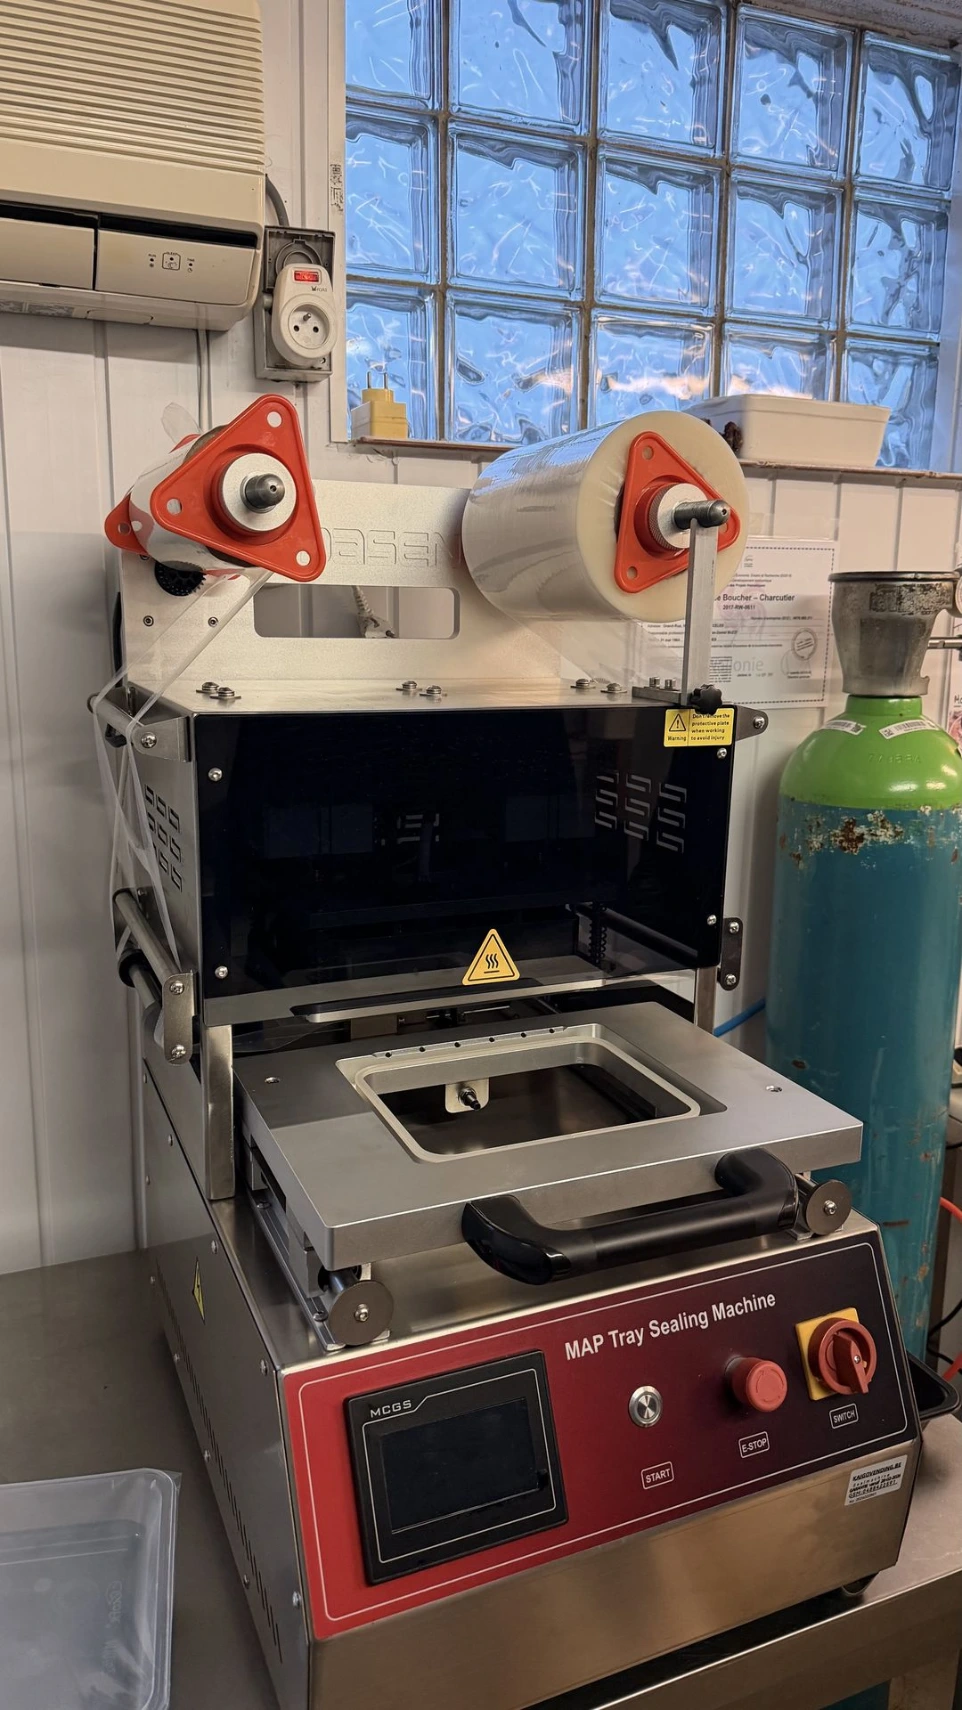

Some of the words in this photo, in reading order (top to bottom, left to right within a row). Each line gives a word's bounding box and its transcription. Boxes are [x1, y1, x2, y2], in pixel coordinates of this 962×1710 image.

[722, 593, 752, 602] Boucher
[759, 593, 795, 602] Charcutier
[565, 1334, 604, 1360] MAP
[608, 1327, 645, 1348] Tray
[649, 1311, 709, 1338] Sealing
[712, 1293, 776, 1322] Machine
[370, 1399, 412, 1418] MCGS
[833, 1409, 855, 1424] SWITCH
[742, 1438, 767, 1453] E-STOP
[645, 1468, 671, 1484] START
